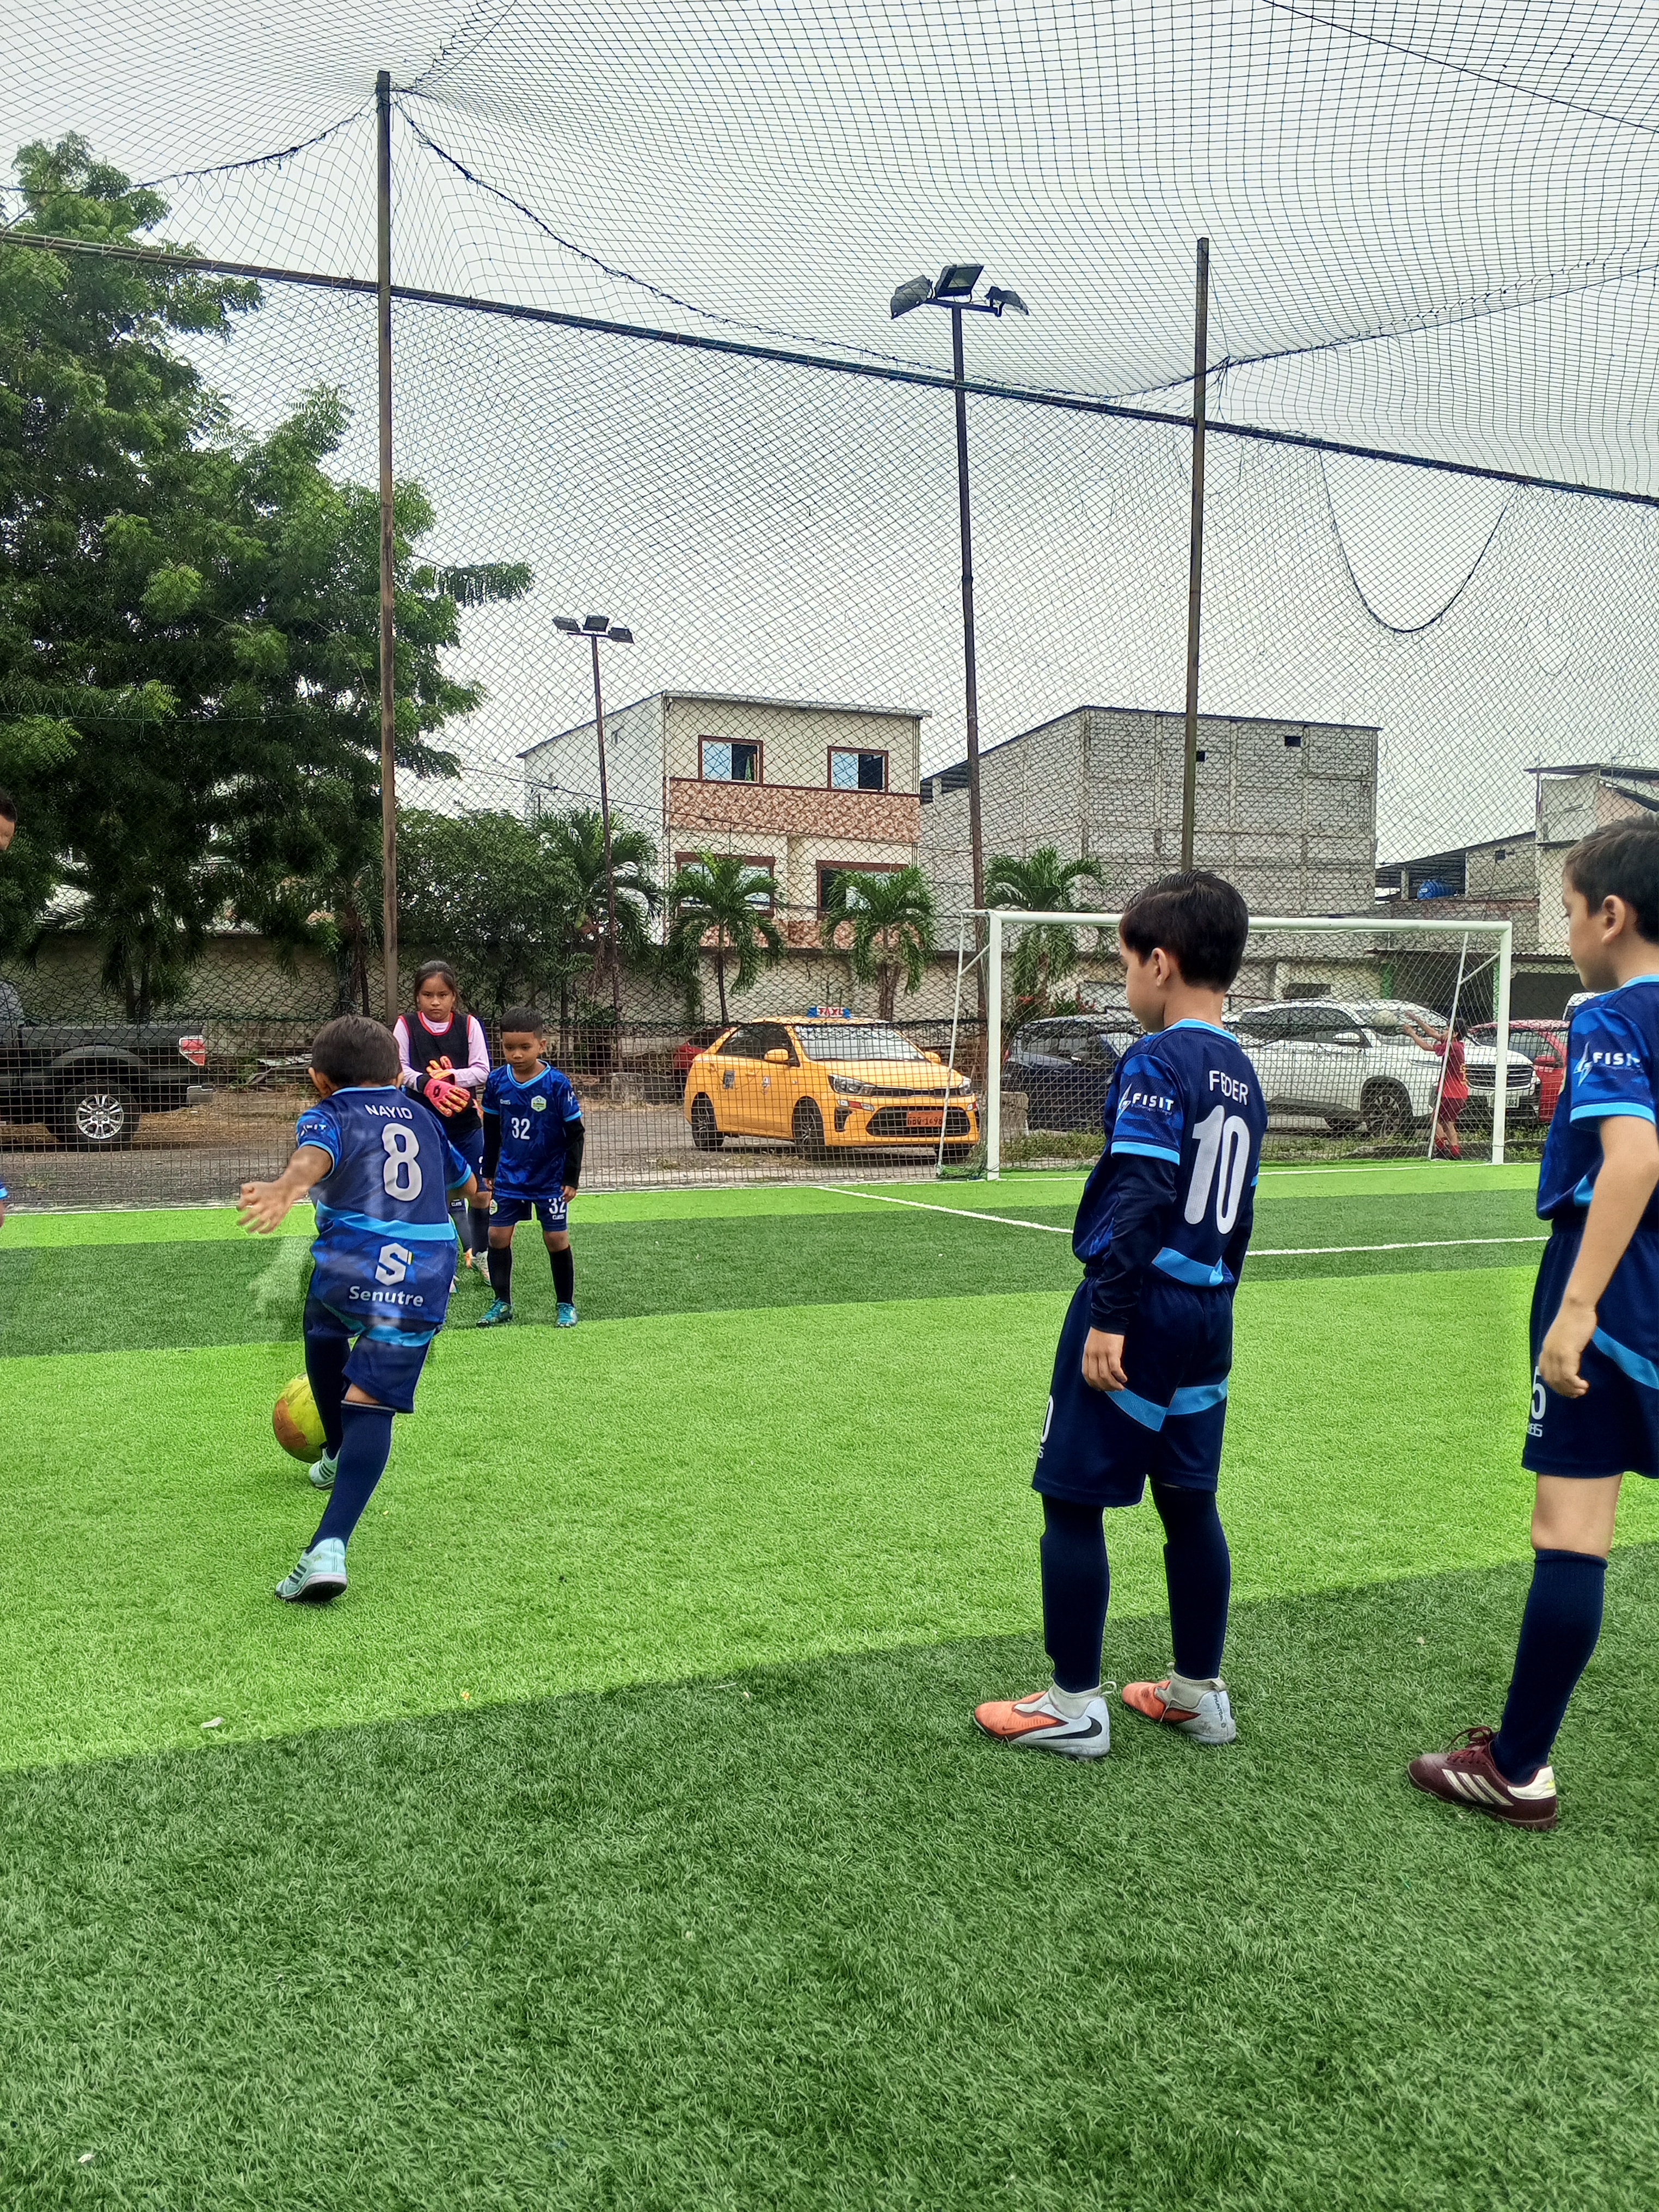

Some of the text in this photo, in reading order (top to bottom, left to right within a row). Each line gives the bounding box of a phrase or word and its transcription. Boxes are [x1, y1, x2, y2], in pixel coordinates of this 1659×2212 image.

[1209, 1070, 1248, 1105] FEDER
[365, 1104, 413, 1120] NAYID
[1132, 1093, 1174, 1111] FISIT
[511, 1117, 530, 1140] 32
[382, 1123, 422, 1201] 8
[1184, 1105, 1250, 1234] 10
[549, 1197, 566, 1214] 32
[349, 1286, 423, 1307] Senutre
